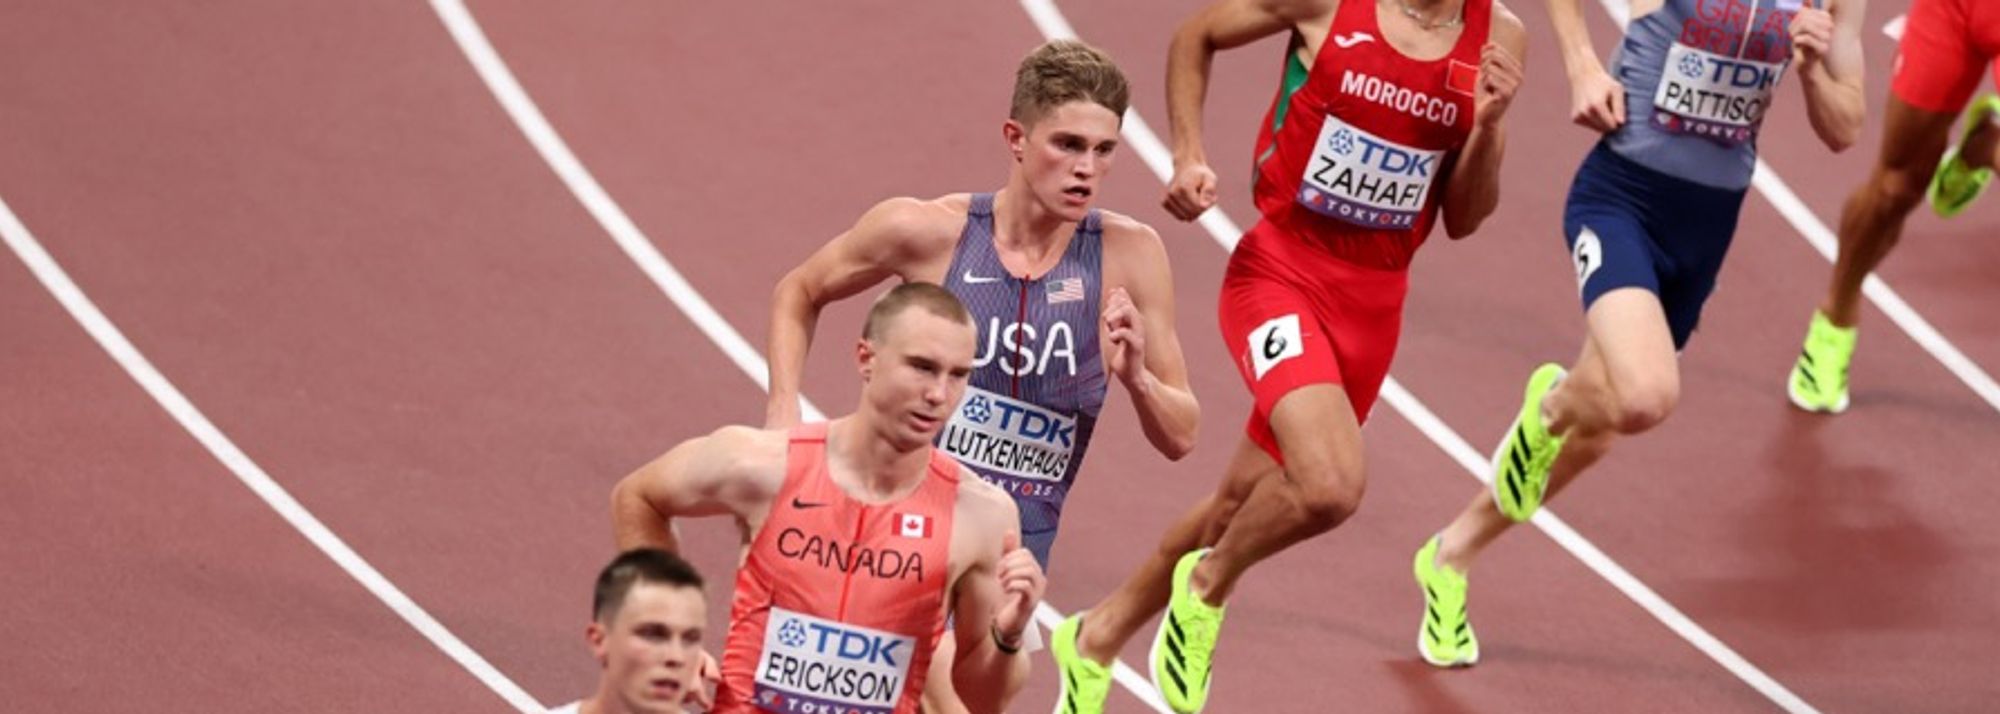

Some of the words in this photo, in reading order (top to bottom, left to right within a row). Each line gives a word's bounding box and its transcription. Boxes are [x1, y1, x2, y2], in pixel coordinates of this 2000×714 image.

[1340, 70, 1458, 127] MOROCCO
[1663, 82, 1763, 122] PATTISO
[1684, 121, 1750, 140] TOKYO
[1358, 136, 1436, 177] TDK
[1312, 154, 1425, 207] ZAHAFI
[1327, 199, 1413, 225] TOKYO25
[1263, 326, 1288, 360] 6
[994, 401, 1075, 448] TDK
[946, 425, 1069, 478] LUTKENHAUS
[777, 528, 924, 583] CANADA
[809, 622, 904, 667] TDK
[764, 652, 898, 702] ERICKSON
[787, 697, 887, 714] TOKY
